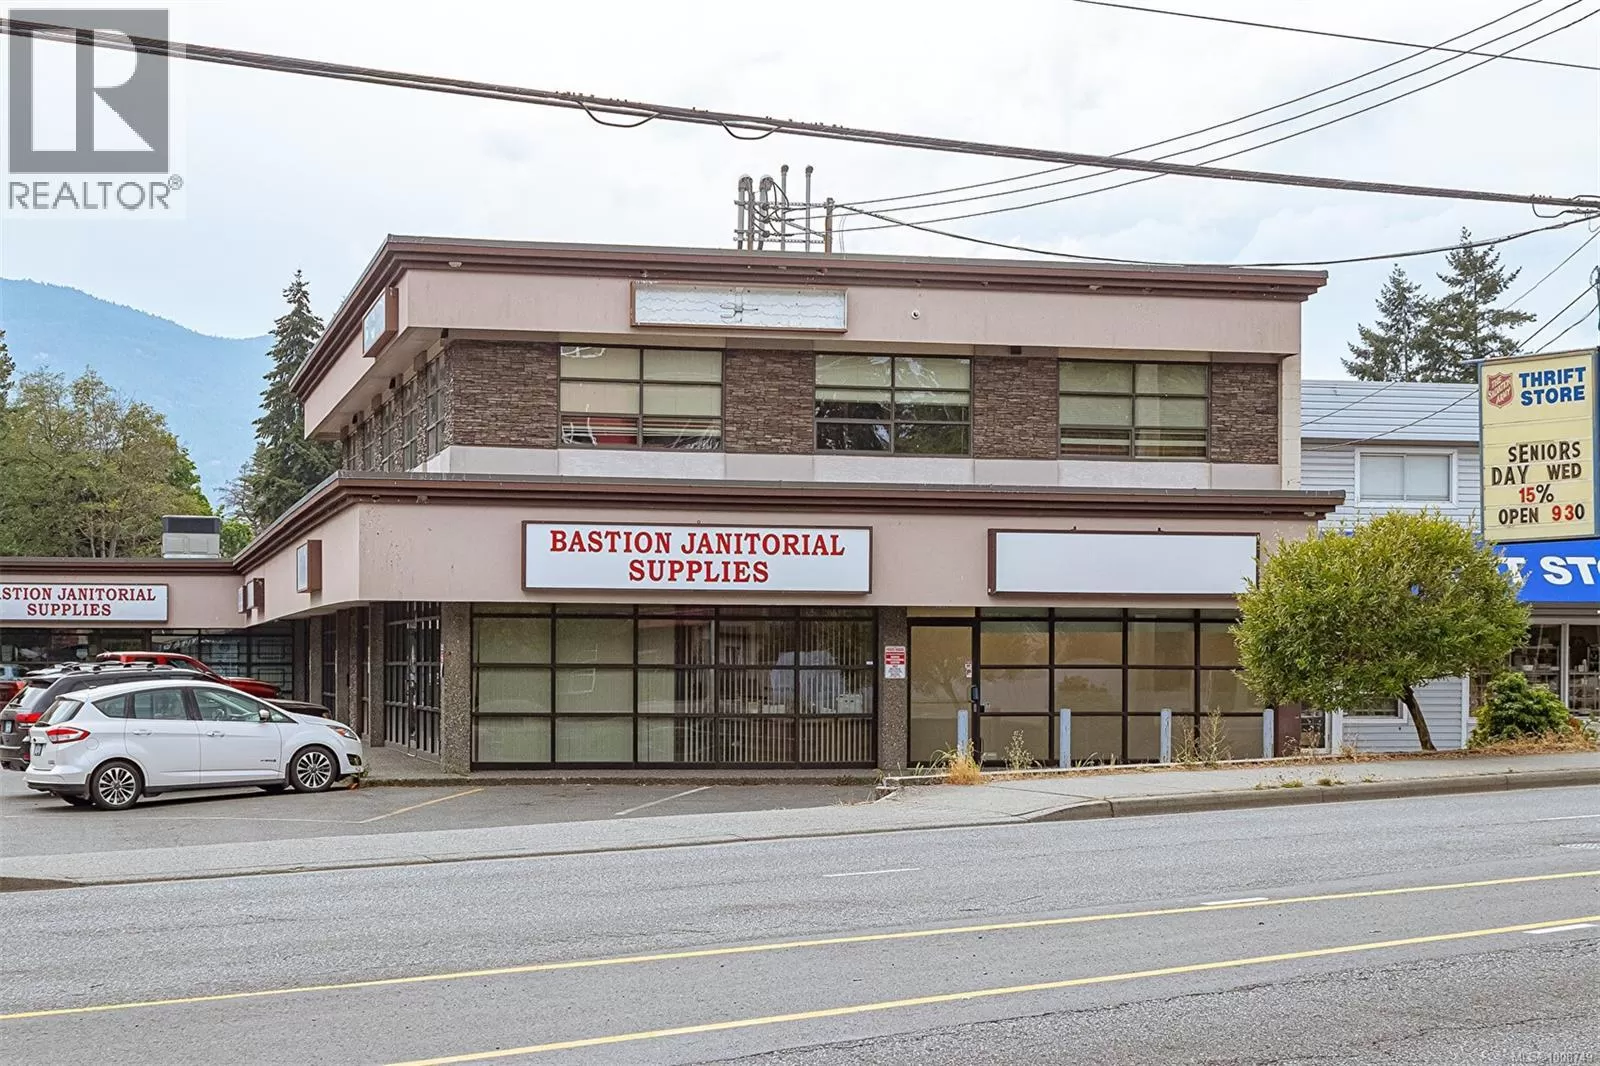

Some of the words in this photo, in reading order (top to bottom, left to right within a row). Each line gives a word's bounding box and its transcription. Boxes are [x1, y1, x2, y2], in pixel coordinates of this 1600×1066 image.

[1518, 366, 1587, 388] THRIFT
[1520, 385, 1586, 407] STORE
[1508, 441, 1581, 463] SENIORS
[1491, 464, 1530, 486] DAY
[1546, 462, 1582, 481] WED
[1518, 483, 1555, 504] 15%
[1498, 506, 1539, 525] OPEN
[549, 530, 672, 554] BASTION
[680, 532, 846, 556] JANITORIAL
[628, 559, 770, 583] SUPPLIES
[1540, 555, 1600, 585] ST
[0, 587, 53, 600] STION
[57, 588, 157, 601] JANITORIAL
[27, 603, 112, 617] SUPPLIES
